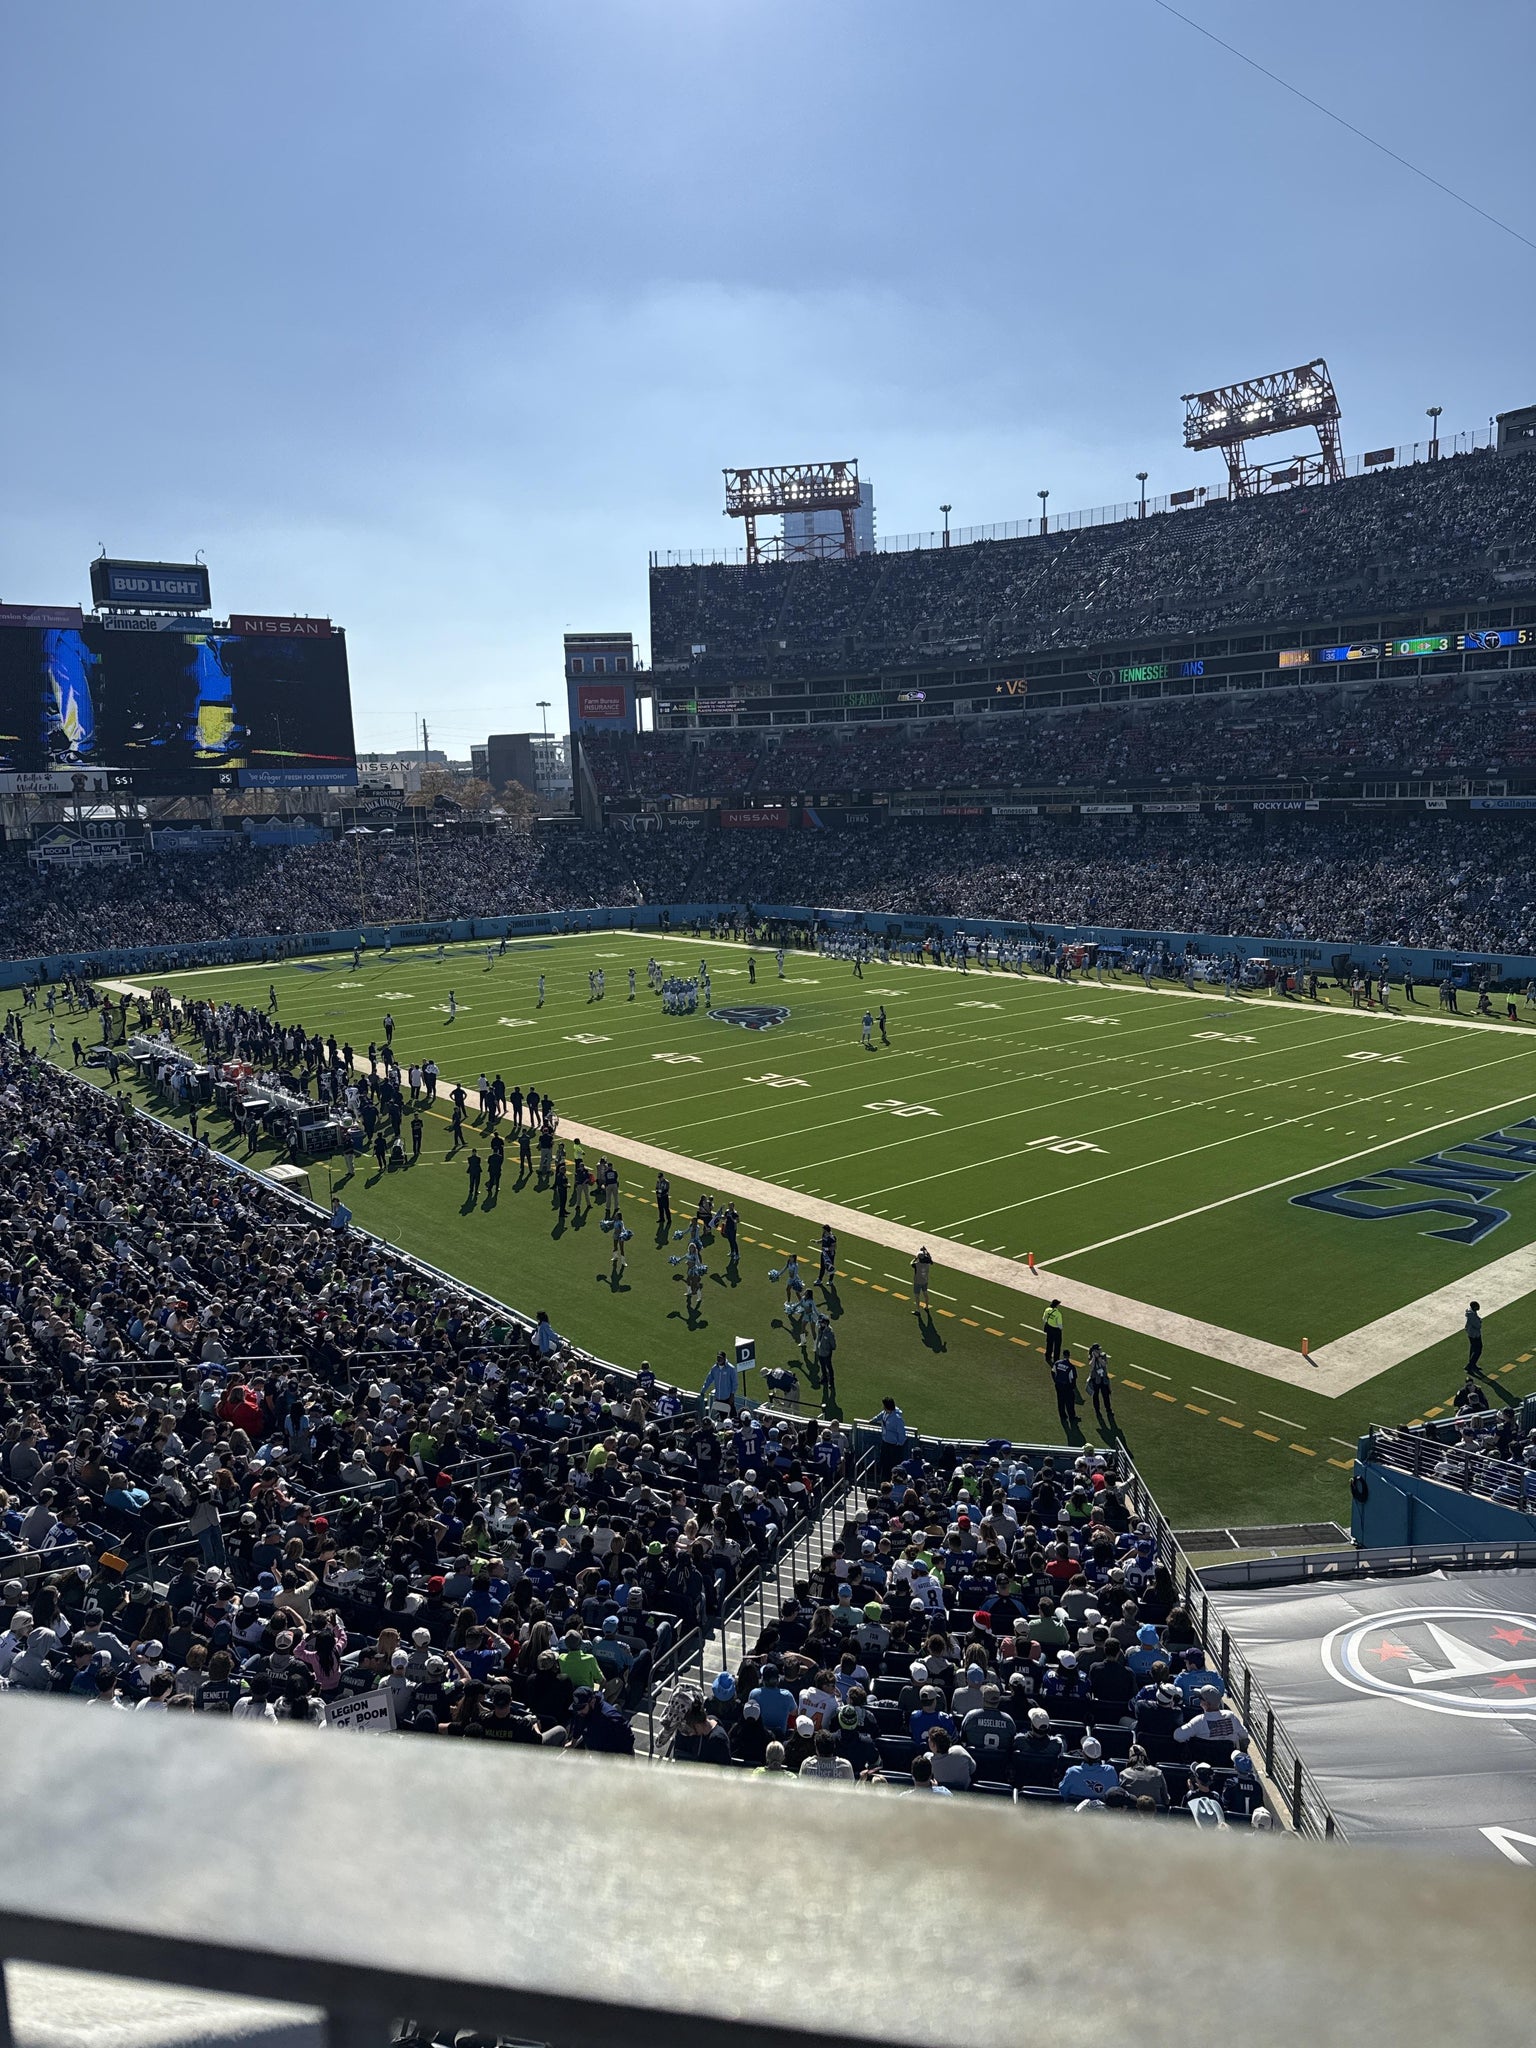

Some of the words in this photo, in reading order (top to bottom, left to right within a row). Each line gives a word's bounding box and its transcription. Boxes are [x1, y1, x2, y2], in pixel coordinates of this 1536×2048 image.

[113, 577, 149, 591] BUD
[150, 579, 198, 594] LIGHT
[245, 621, 318, 633] NISSAN
[1400, 642, 1410, 654] 0
[1438, 639, 1448, 651] 3
[1006, 680, 1029, 695] VS
[356, 762, 410, 771] NISSAN
[996, 807, 1033, 815] Tennessean
[1253, 802, 1280, 811] ROCKY
[1282, 801, 1302, 810] LAW
[677, 816, 701, 829] Kroger
[729, 813, 779, 822] NISSAN
[1262, 946, 1298, 958] TENNESSEE
[742, 1072, 803, 1088] 30
[861, 1099, 937, 1117] 20
[1025, 1135, 1100, 1154] 10
[741, 1347, 750, 1360] D
[695, 1441, 711, 1461] 12
[745, 1439, 756, 1455] 11
[927, 1589, 938, 1607] 8
[265, 1668, 290, 1681] TITANS
[202, 1690, 230, 1700] BENNETT
[331, 1700, 369, 1719] LEGION
[337, 1717, 351, 1729] OF
[355, 1707, 388, 1723] BOOM
[977, 1718, 1008, 1729] HASSELBECK
